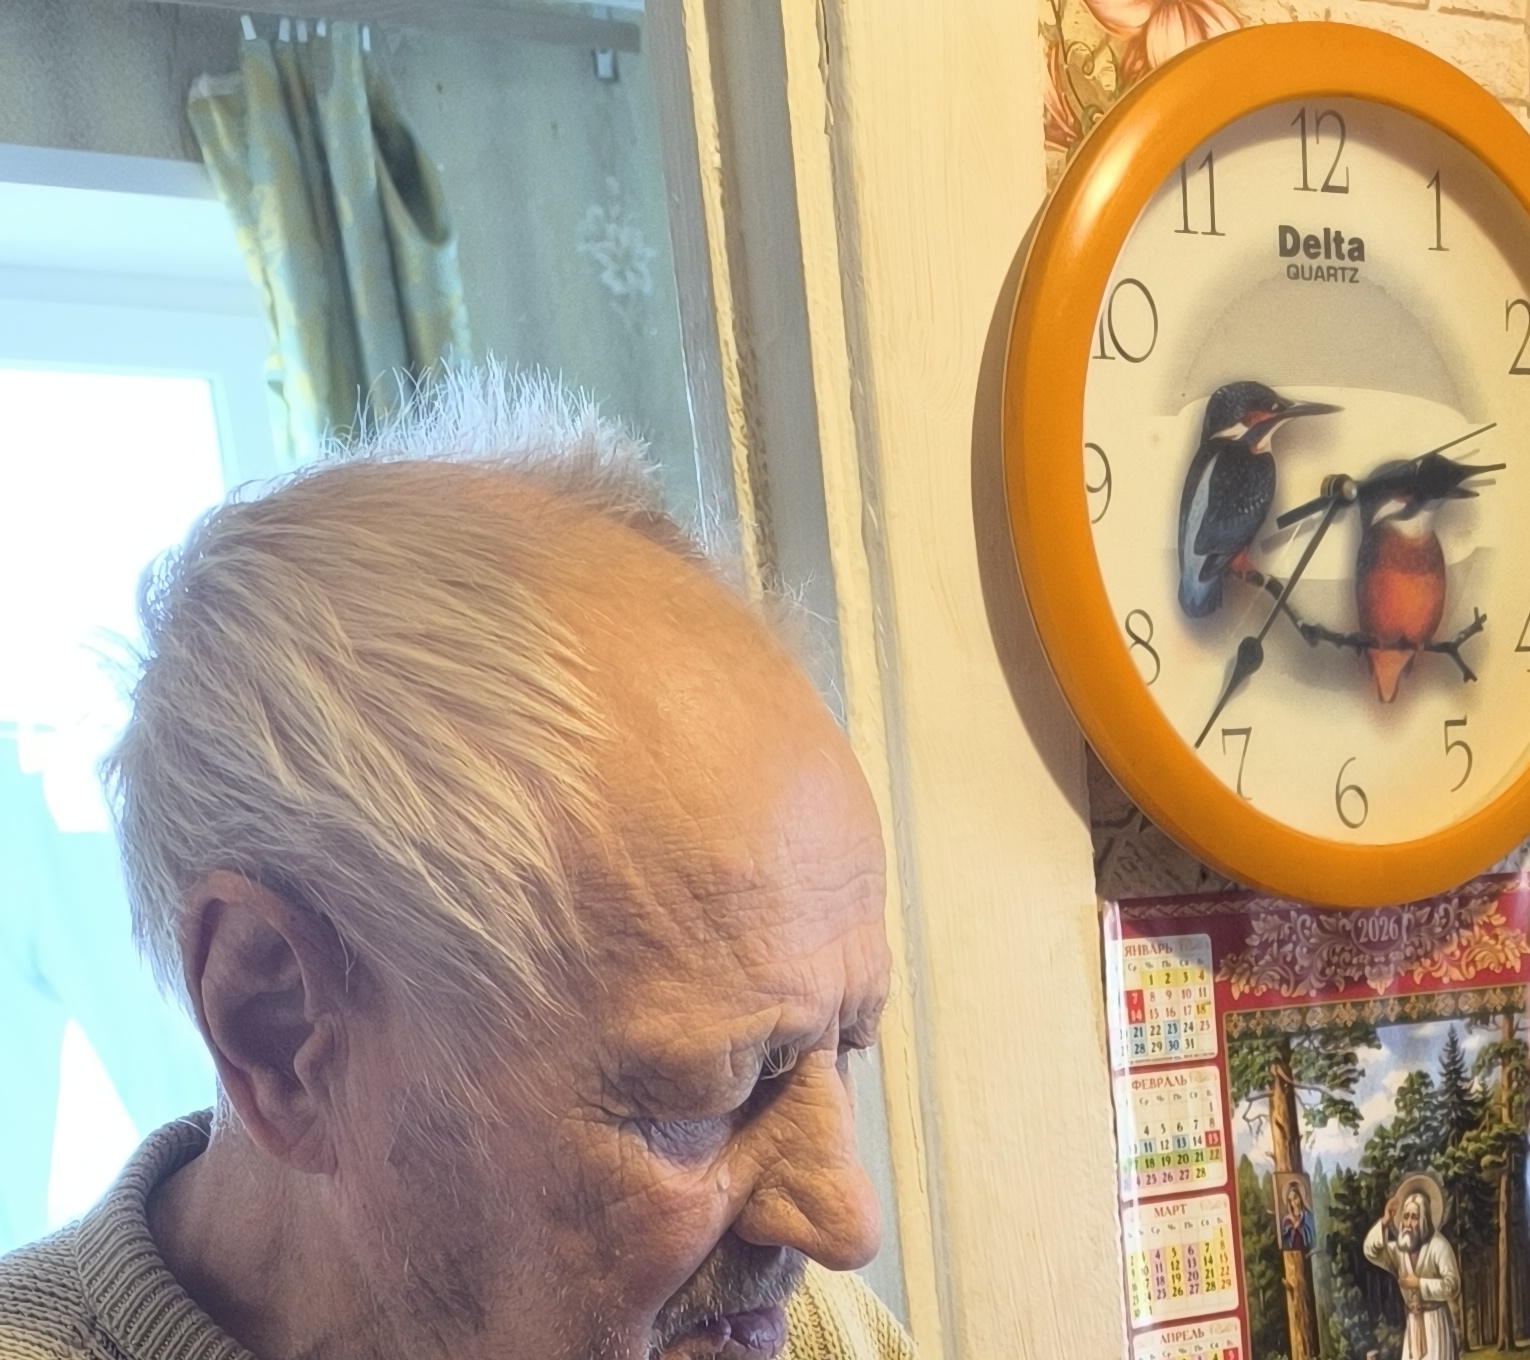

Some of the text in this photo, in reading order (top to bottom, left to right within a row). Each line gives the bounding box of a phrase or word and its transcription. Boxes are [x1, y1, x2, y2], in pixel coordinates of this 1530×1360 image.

[1291, 108, 1350, 194] 12
[1174, 149, 1226, 237] 11
[1426, 169, 1450, 251] 1
[1278, 224, 1366, 264] Delta
[1286, 263, 1361, 284] QUARTZ
[1091, 277, 1159, 363] 10
[1084, 442, 1113, 524] 9
[1124, 609, 1162, 685] 8
[1222, 726, 1253, 801] 7
[1444, 715, 1473, 792] 5
[1335, 756, 1368, 828] 6
[1125, 943, 1172, 956] ЯНВАРЬ
[1358, 917, 1398, 942] 2026
[1132, 1075, 1187, 1090] ФЕВРАЛЬ
[1154, 1204, 1187, 1218] МАРТ
[1160, 1328, 1204, 1343] АПРЕЛЬ
